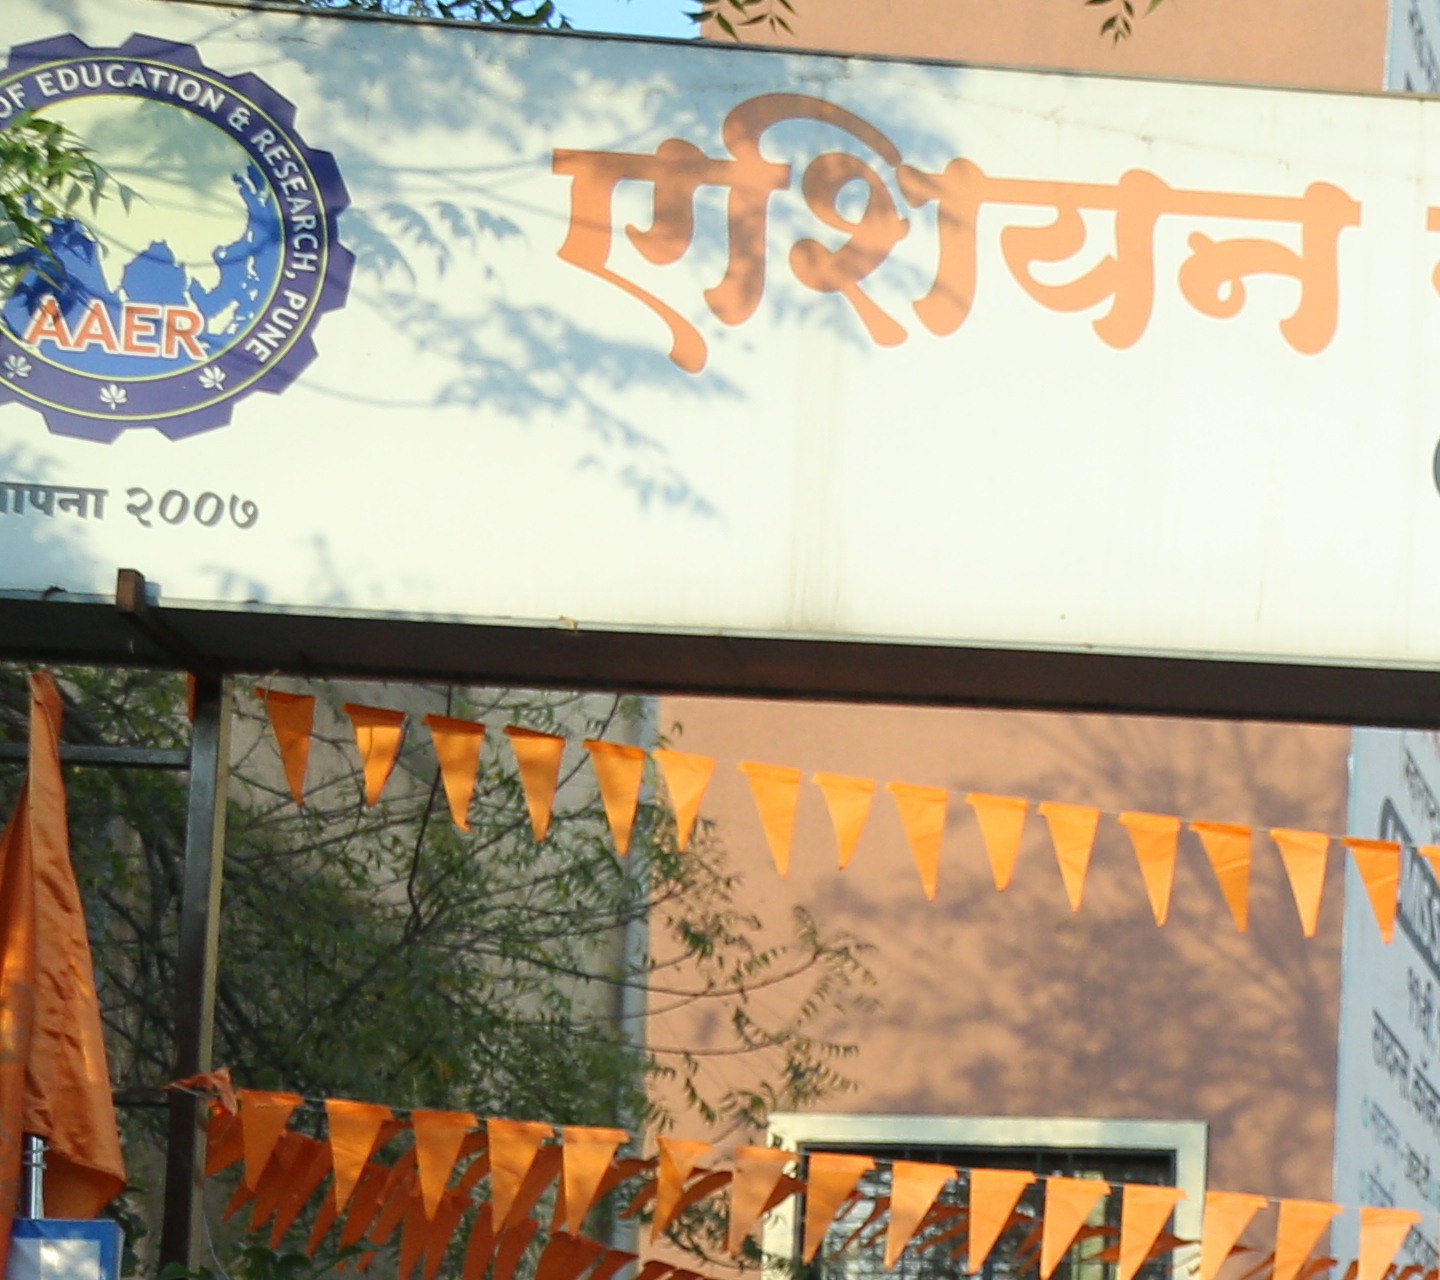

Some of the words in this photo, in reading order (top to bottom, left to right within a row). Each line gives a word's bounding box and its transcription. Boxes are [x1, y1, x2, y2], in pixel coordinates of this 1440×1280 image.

[36, 63, 226, 113] EDUCATION
[227, 106, 251, 132] &
[250, 128, 318, 283] RESEARCH,
[551, 92, 1361, 374] एशियन
[26, 295, 211, 363] AAER
[244, 289, 309, 364] PUNE
